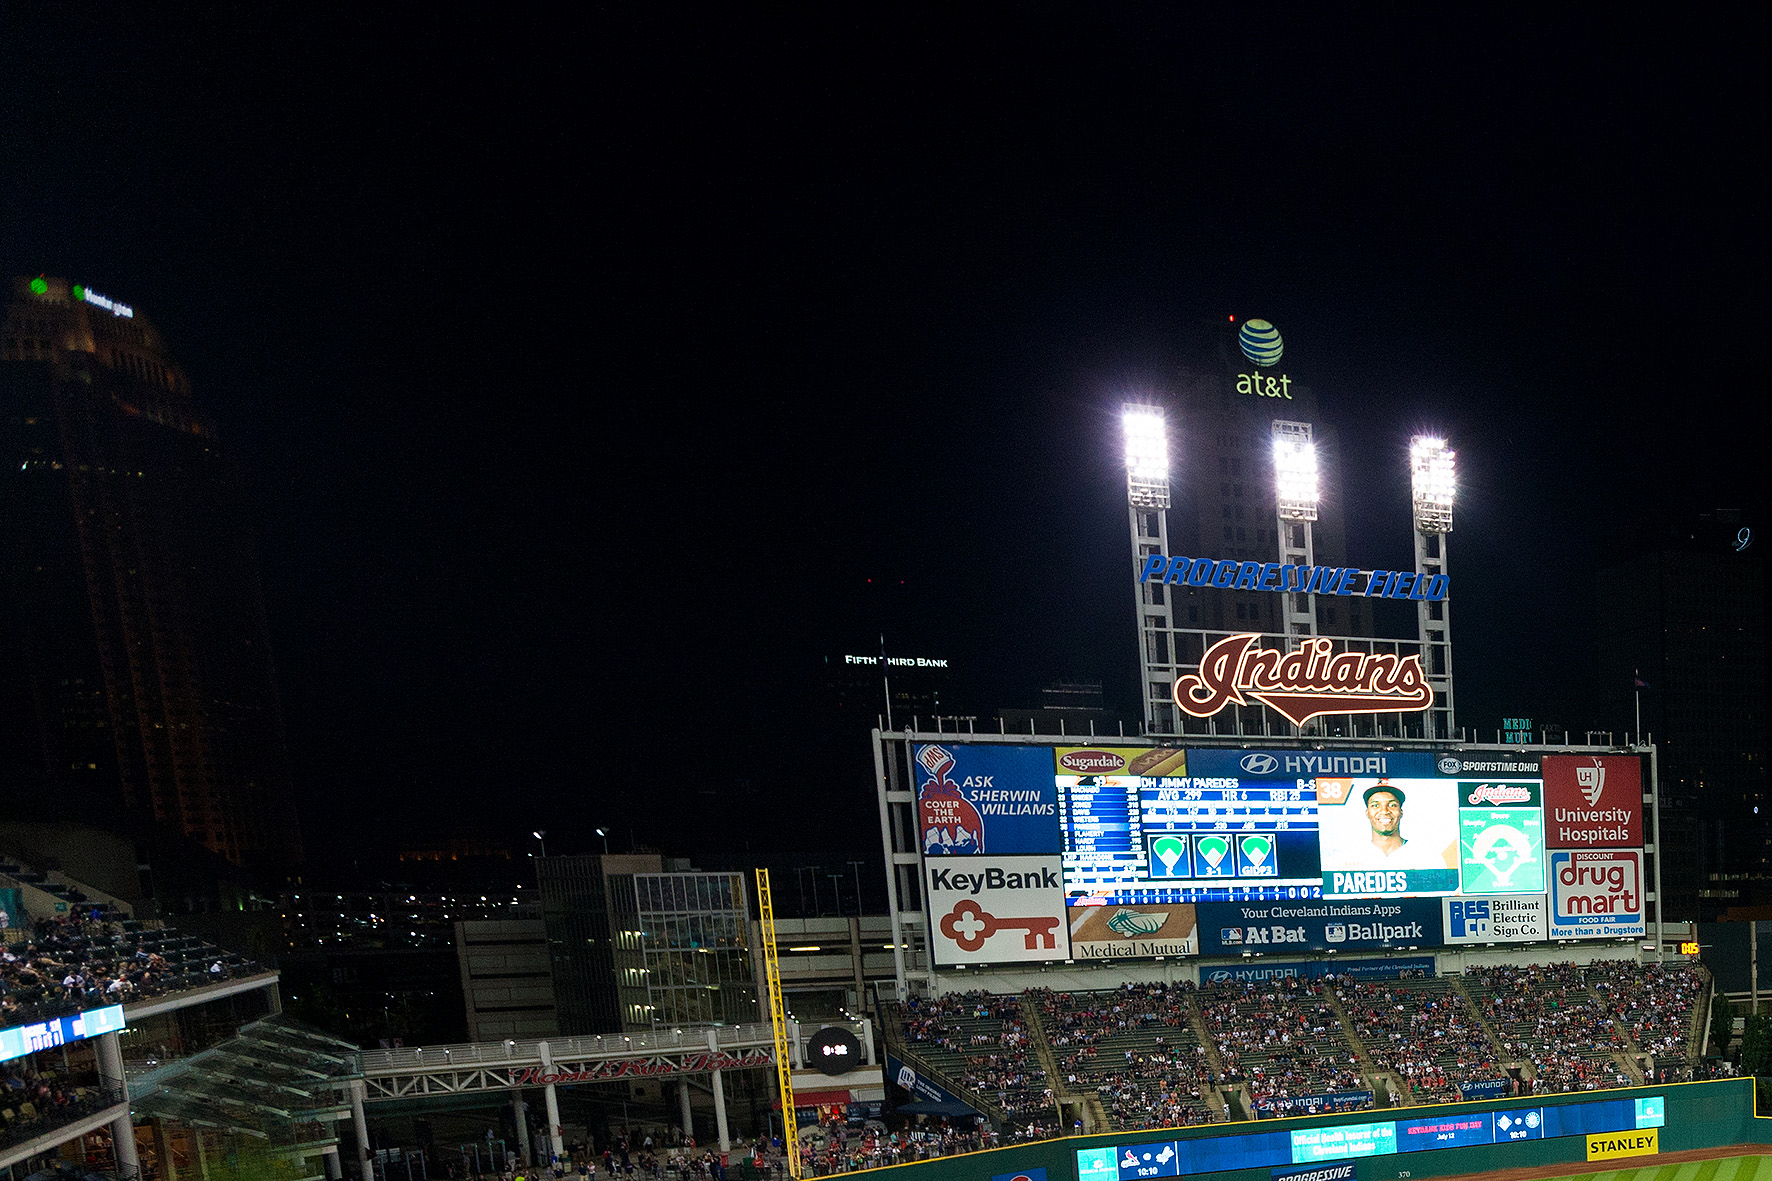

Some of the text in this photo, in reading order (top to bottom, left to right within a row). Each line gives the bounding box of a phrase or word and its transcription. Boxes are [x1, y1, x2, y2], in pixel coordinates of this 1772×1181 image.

[1236, 371, 1292, 399] at&t
[1139, 554, 1451, 600] PROGRESSIVE FIELD
[845, 655, 877, 665] FIFTH
[916, 658, 948, 667] BANK
[1173, 633, 1434, 727] Indians
[1062, 752, 1126, 771] Sugardale
[1285, 756, 1387, 774] HYUNDAI
[1443, 761, 1539, 772] FOX SPORTSTIME OHIO
[962, 776, 994, 788] ASK
[1141, 778, 1156, 788] DH
[1159, 778, 1191, 788] JIMMY
[1193, 778, 1239, 788] PAREDES
[1580, 772, 1592, 782] UH
[970, 790, 1041, 802] SHERWIN
[1321, 782, 1343, 799] 38
[1468, 784, 1531, 806] Indians
[925, 801, 960, 809] COVER
[981, 804, 1055, 815] WILLIAMS
[928, 816, 962, 824] EARTH
[1555, 807, 1632, 825] University
[1559, 826, 1629, 844] Hospitals
[1576, 853, 1614, 861] DISCOUNT
[1560, 853, 1624, 893] drug
[931, 867, 1060, 895] KeyBank
[1333, 872, 1407, 893] PAREDES
[1493, 900, 1539, 911] Brilliant
[1567, 889, 1640, 915] mart
[1241, 905, 1401, 919] Your Cleveland Indians Apps
[1493, 913, 1537, 923] Electric
[1579, 916, 1598, 924] FOOD
[1245, 926, 1306, 943] At Bat
[1349, 922, 1422, 942] Ballpark
[1493, 925, 1539, 937] Sign Co.
[1551, 928, 1573, 937] More
[1575, 927, 1595, 936] than
[1603, 926, 1644, 936] Drugstore
[1081, 940, 1191, 957] Medical Mutual
[1236, 969, 1297, 981] HYUNDAI
[1591, 1136, 1653, 1154] STANLEY
